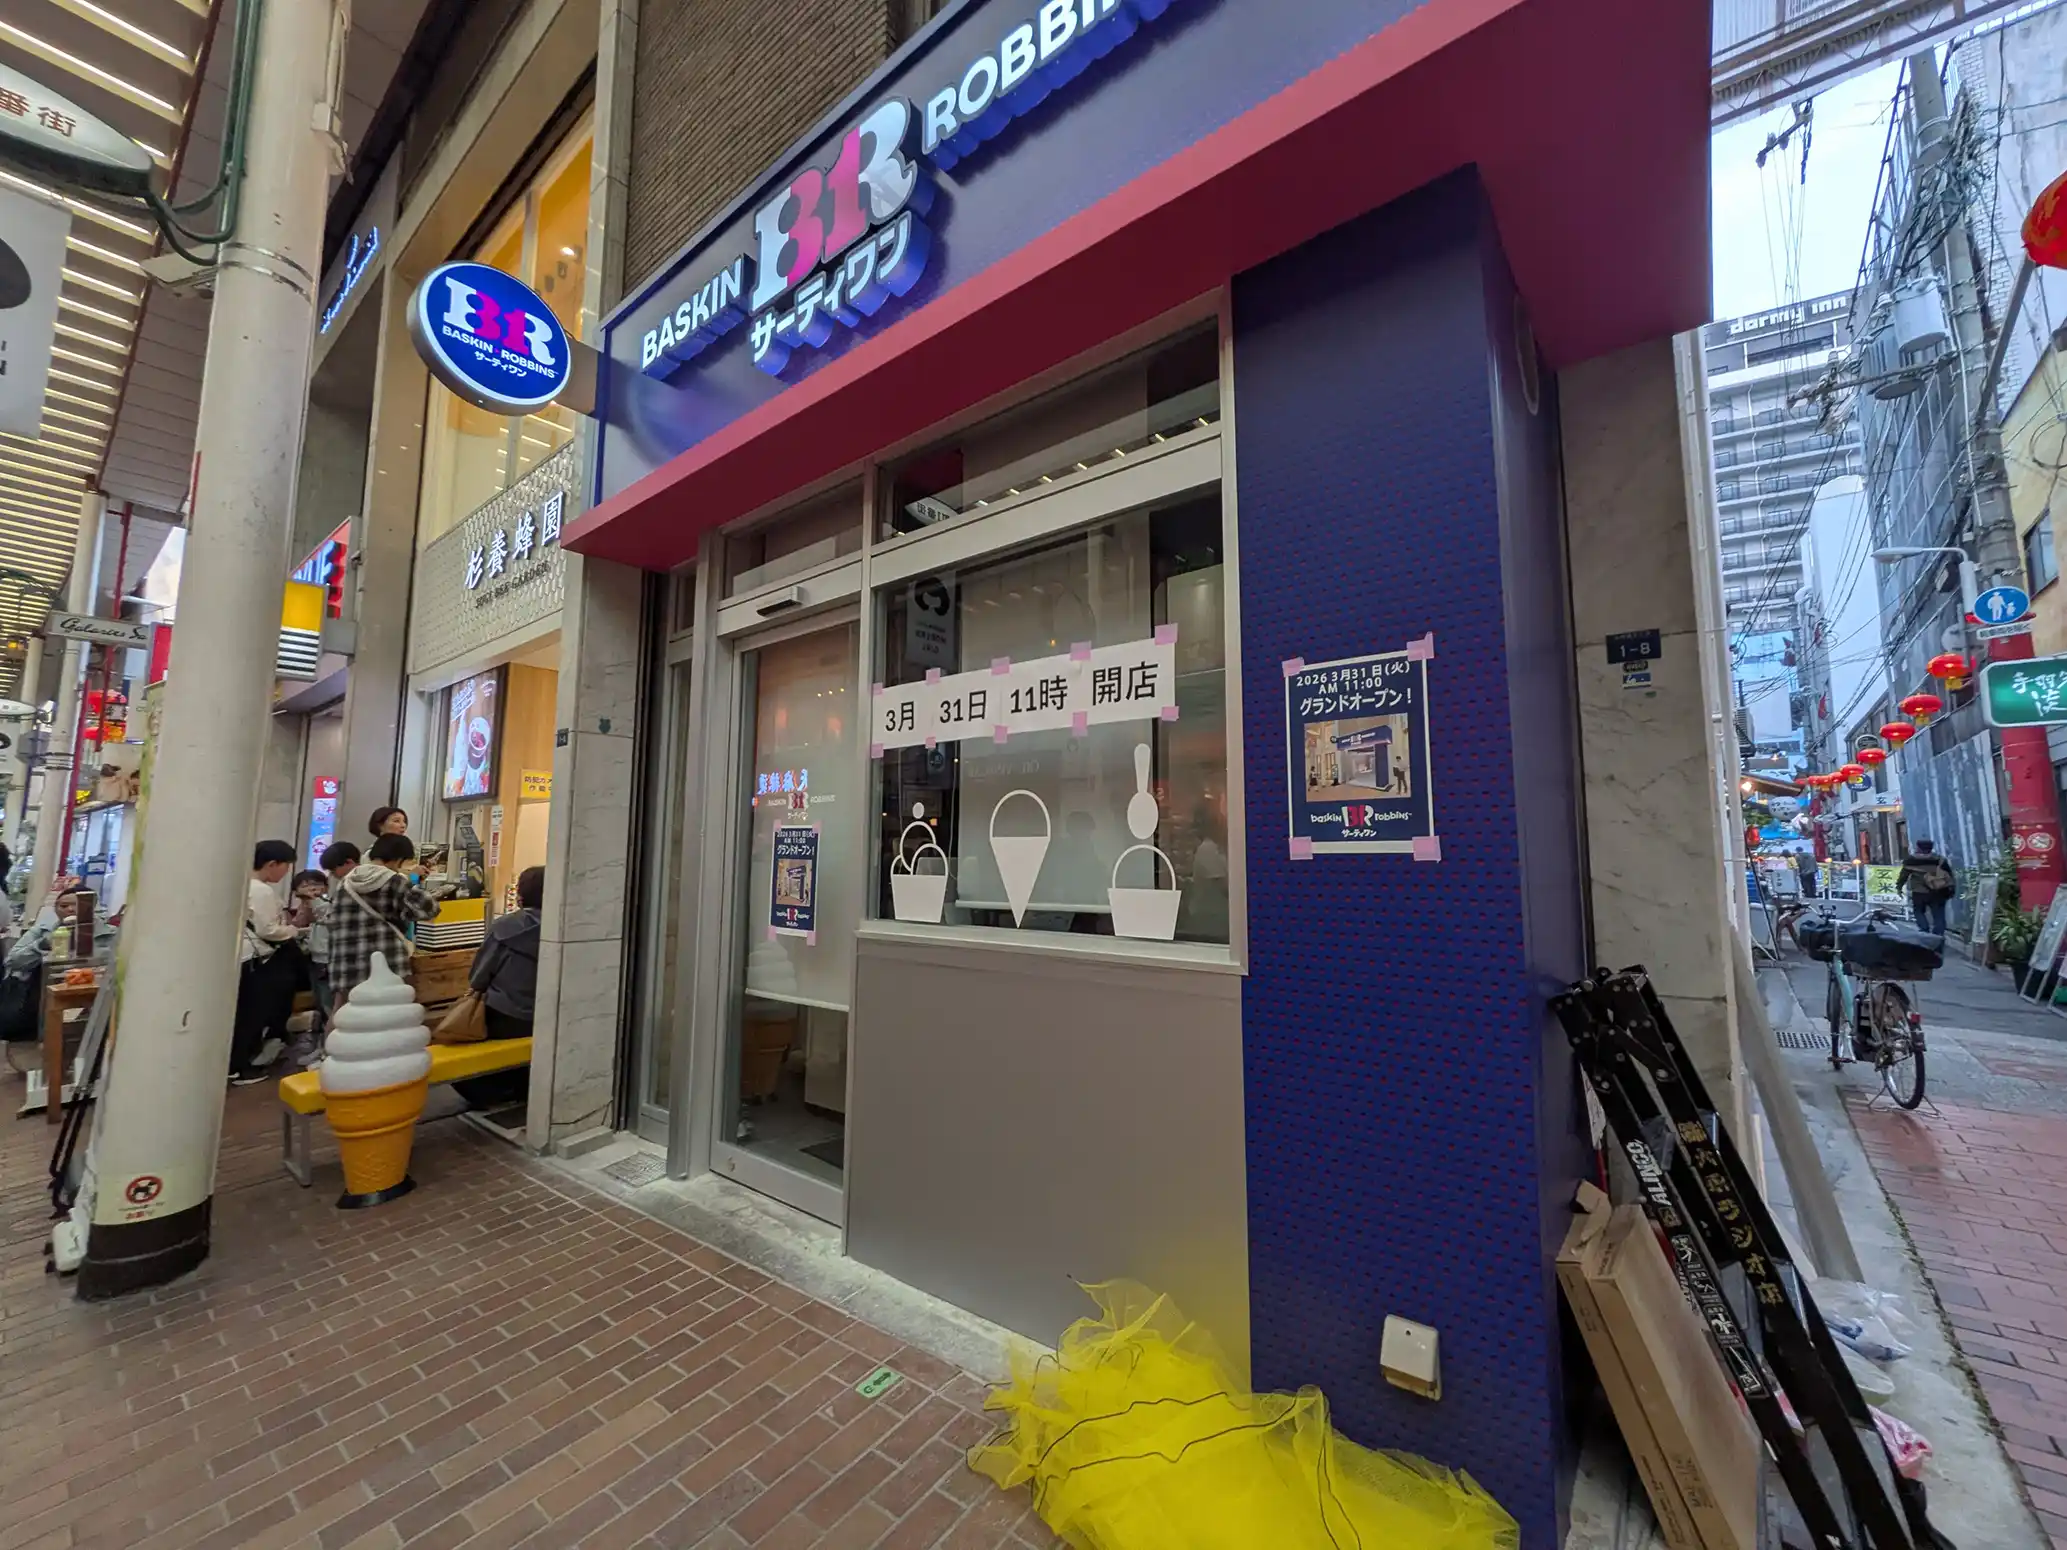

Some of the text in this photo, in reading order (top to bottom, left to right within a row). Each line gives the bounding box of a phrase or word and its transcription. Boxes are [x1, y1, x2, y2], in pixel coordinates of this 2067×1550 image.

[751, 216, 911, 364] サーティワン
[641, 257, 743, 369] BASKIN
[1811, 296, 1846, 314] inn
[442, 325, 555, 379] BASKIN ROBBINS
[474, 351, 527, 377] サーティワン
[464, 491, 563, 590] 杉養蜂園
[1296, 672, 1328, 688] 2026
[1318, 676, 1383, 695] AM 11:00
[884, 662, 1159, 732] 3月 31日 11時 開店
[1300, 688, 1412, 716] グランドオープン!
[1341, 829, 1377, 838] サーティワン
